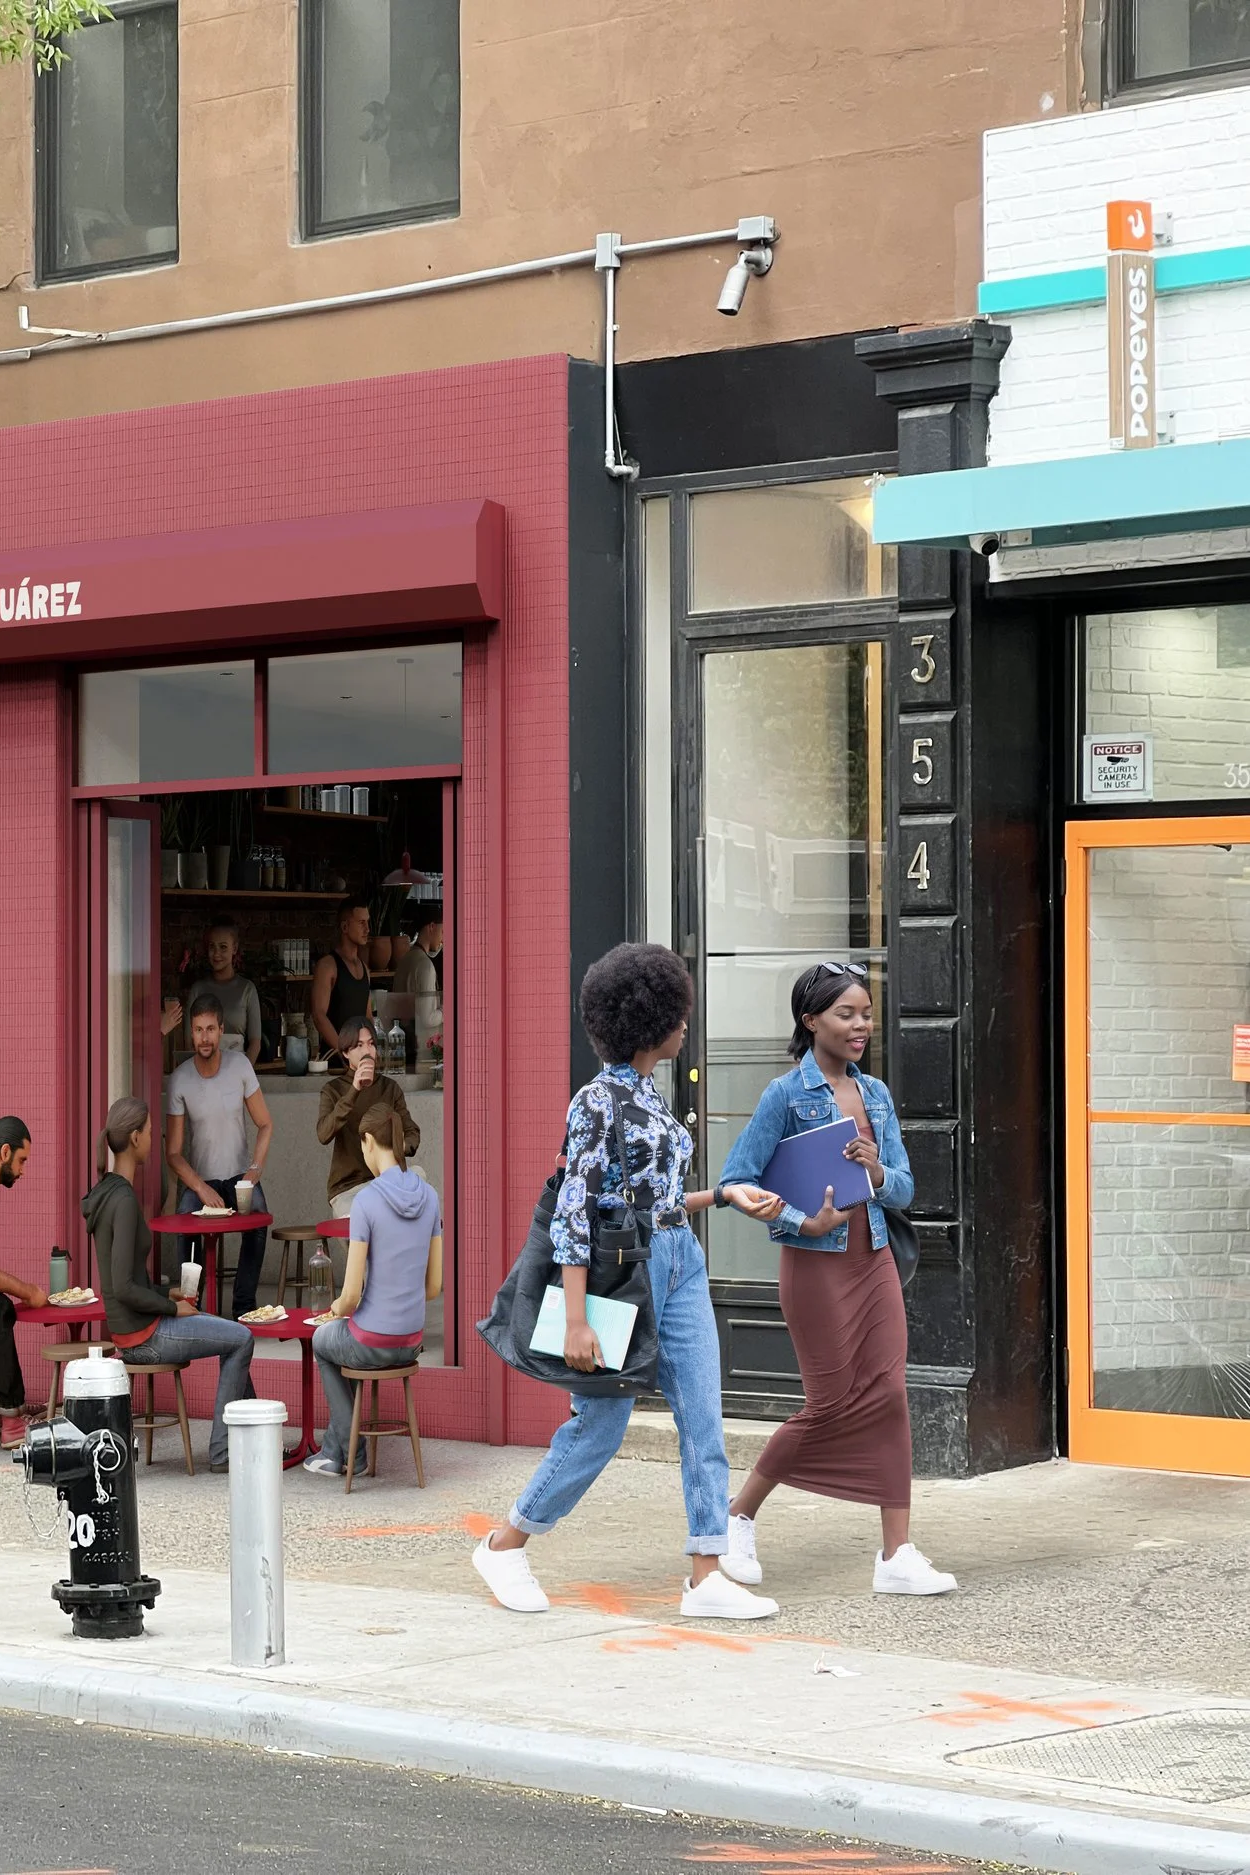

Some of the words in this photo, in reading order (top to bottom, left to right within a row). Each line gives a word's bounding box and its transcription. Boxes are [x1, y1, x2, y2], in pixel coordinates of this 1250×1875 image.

[1096, 745, 1140, 755] NOTICE
[1097, 765, 1138, 774] SECURITY
[1097, 773, 1138, 782] CAMERAS
[1103, 781, 1112, 789] IN
[1114, 780, 1131, 789] USE
